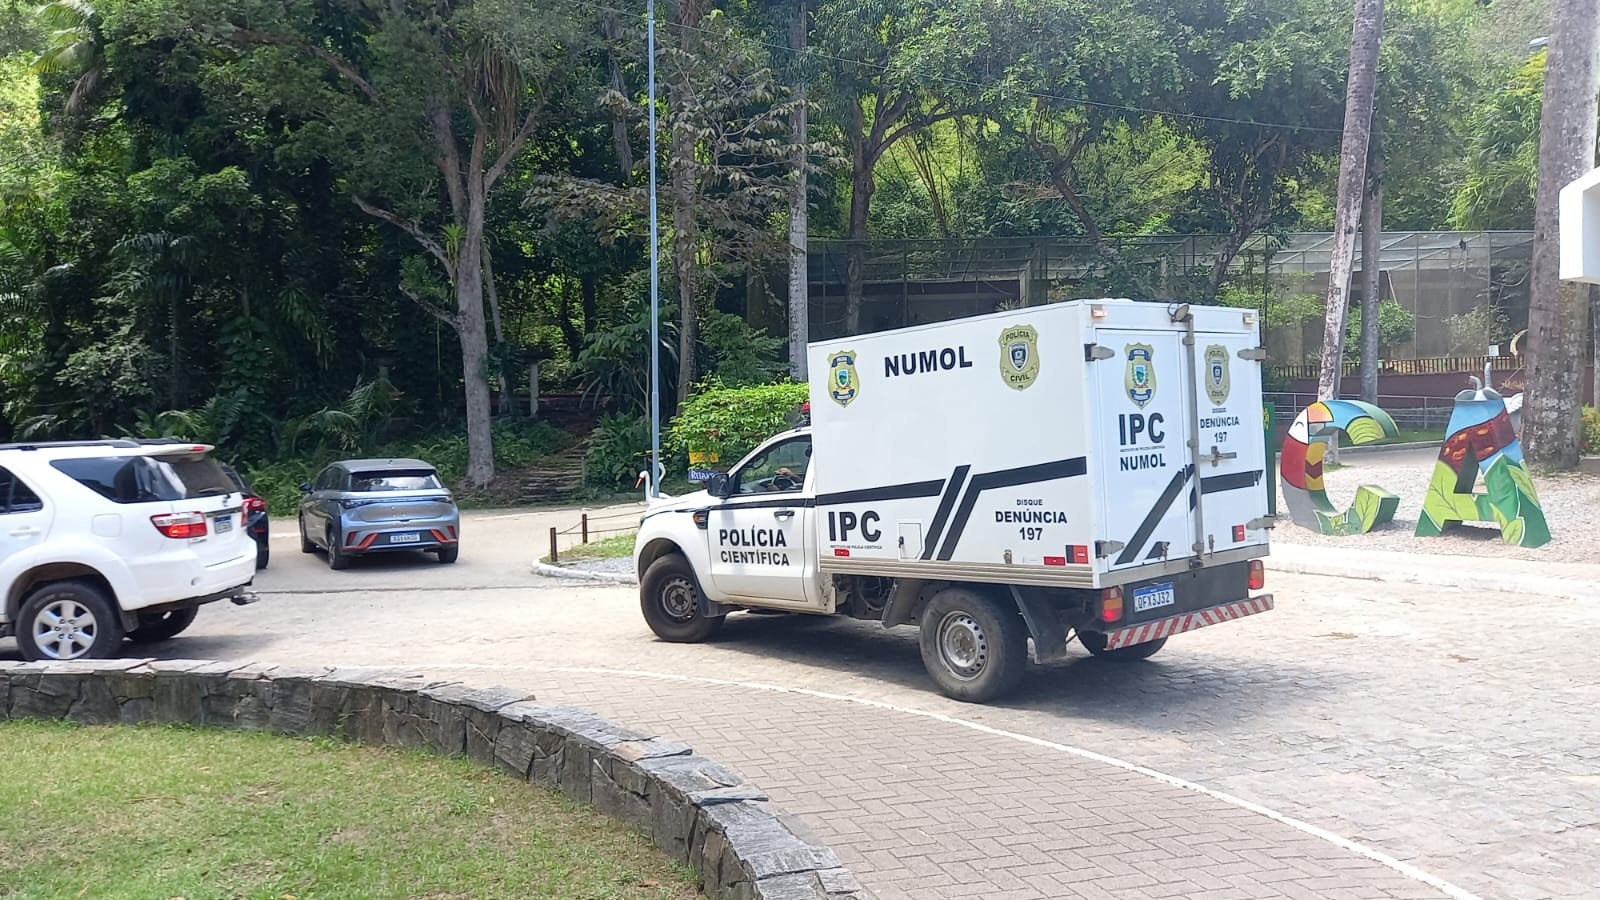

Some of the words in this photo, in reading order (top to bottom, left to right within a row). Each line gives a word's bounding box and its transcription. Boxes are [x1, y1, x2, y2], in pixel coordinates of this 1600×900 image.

[884, 346, 973, 378] NUMOL
[1010, 374, 1031, 382] CIVIL
[1118, 412, 1165, 446] IPC
[1200, 416, 1240, 429] DENÚNCIA
[1214, 431, 1228, 443] 197
[1119, 453, 1167, 471] NUMOL
[995, 508, 1068, 524] DENÚNCIA
[828, 510, 882, 543] IPC
[1019, 527, 1043, 541] 197
[719, 524, 787, 548] POLÍCIA
[720, 549, 790, 567] CIENTÍFICA
